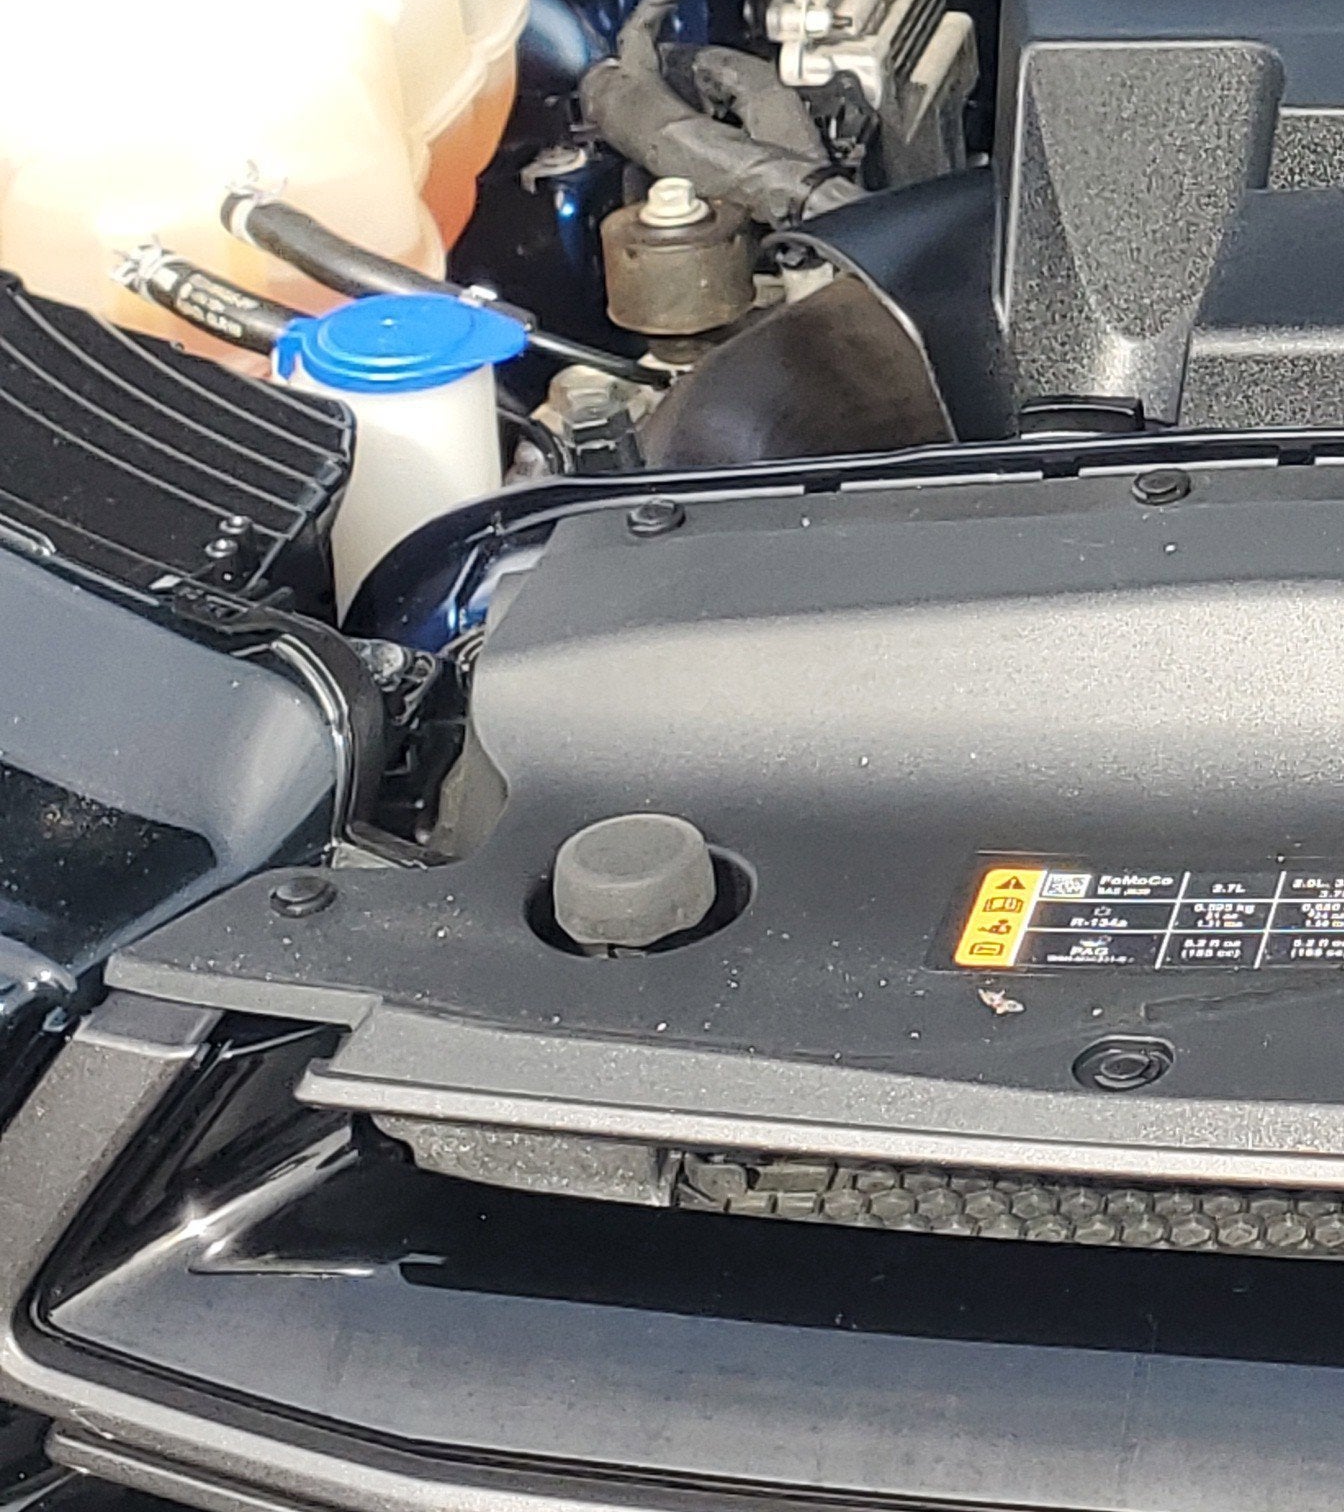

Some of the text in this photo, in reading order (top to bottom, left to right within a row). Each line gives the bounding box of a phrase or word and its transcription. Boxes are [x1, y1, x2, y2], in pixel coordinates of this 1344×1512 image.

[1099, 875, 1174, 887] FoMoCo
[1212, 883, 1246, 894] 2.7L
[1069, 917, 1129, 928] R-134a
[1069, 946, 1109, 956] PAG
